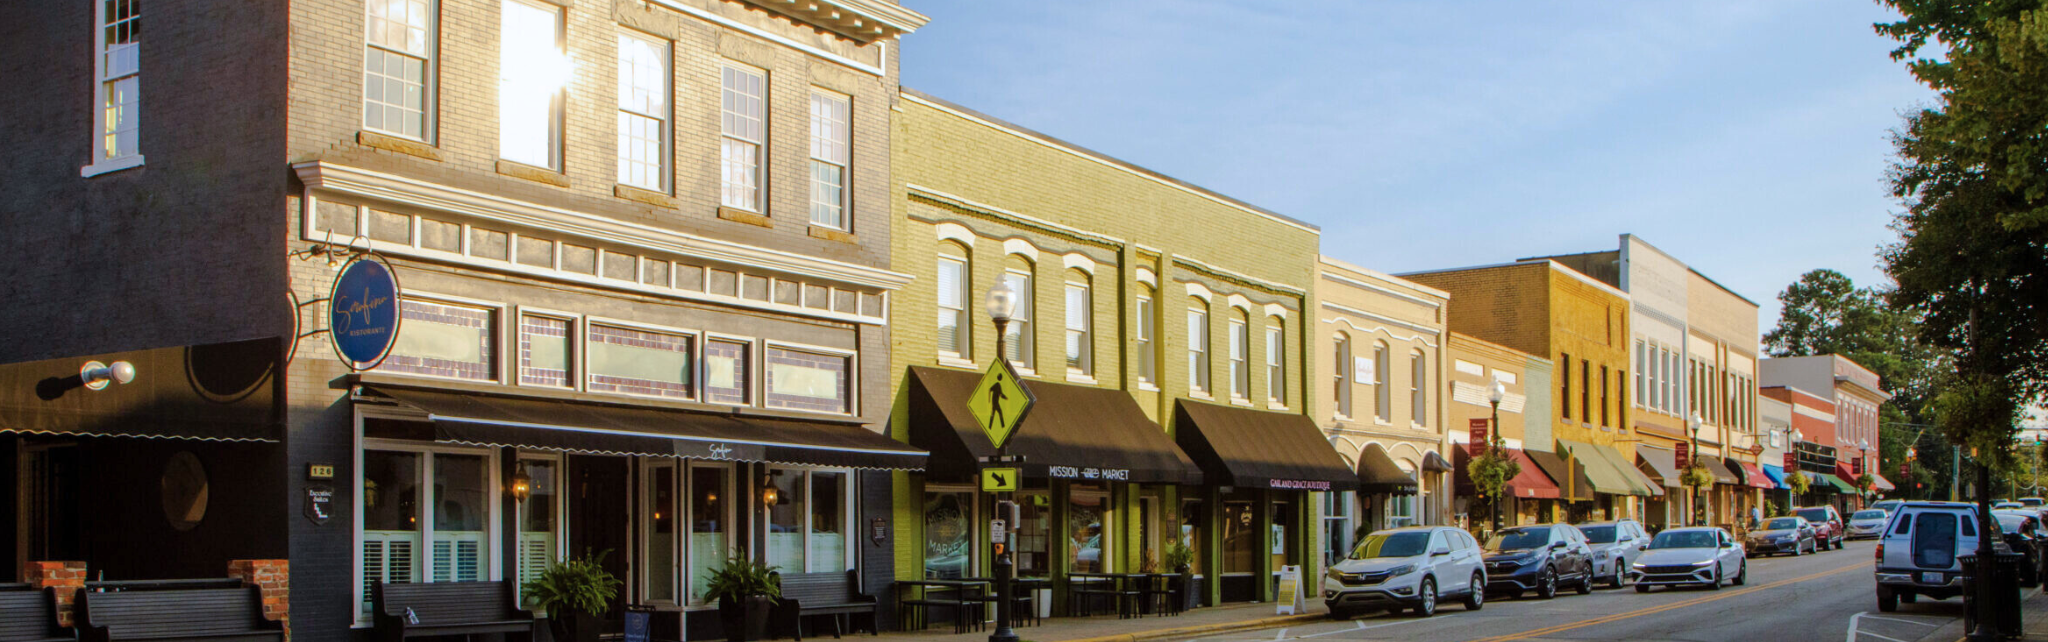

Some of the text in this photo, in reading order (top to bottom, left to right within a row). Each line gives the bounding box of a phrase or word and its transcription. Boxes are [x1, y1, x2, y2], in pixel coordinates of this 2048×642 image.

[313, 467, 331, 475] 126
[1049, 465, 1129, 480] MISSION MARKET
